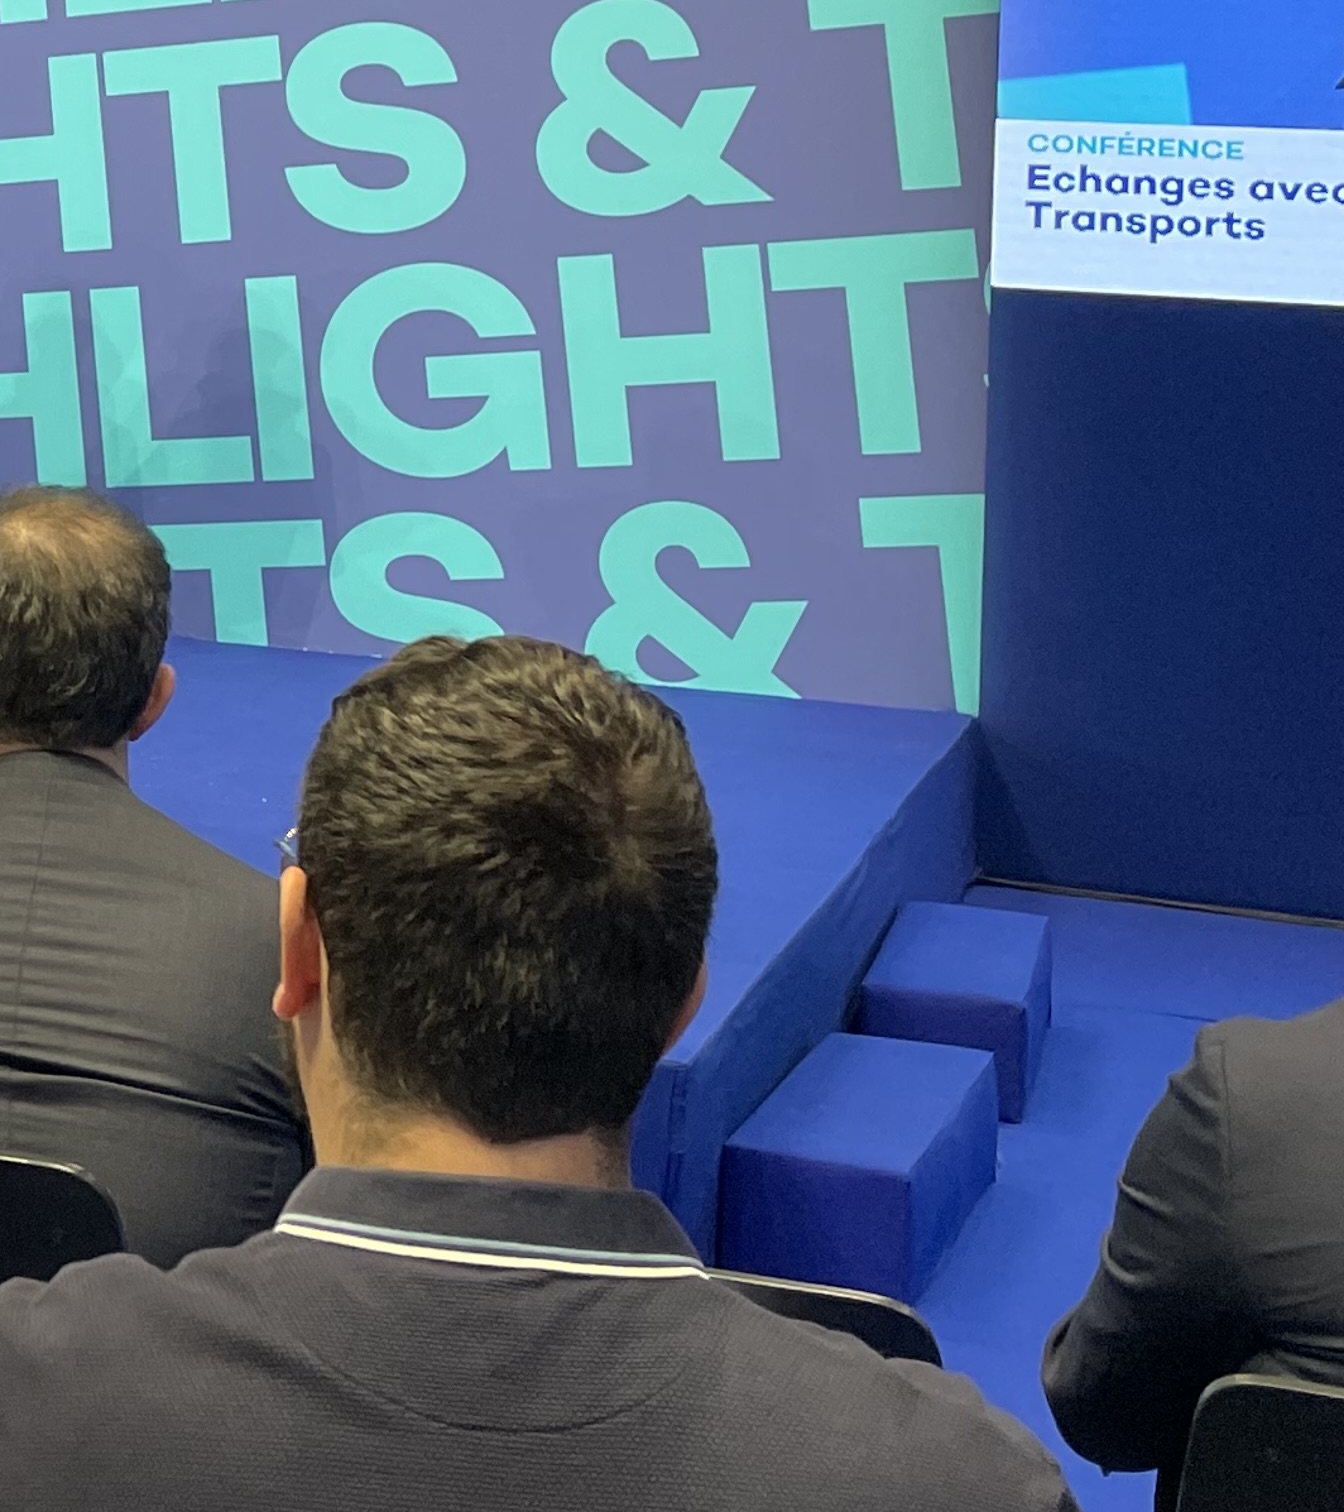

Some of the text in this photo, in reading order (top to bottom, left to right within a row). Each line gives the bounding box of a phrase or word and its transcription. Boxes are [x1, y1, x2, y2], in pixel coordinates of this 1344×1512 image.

[1027, 131, 1244, 160] CONFÉRENCE
[1027, 164, 1234, 206] Echanges
[1025, 200, 1266, 244] Transports
